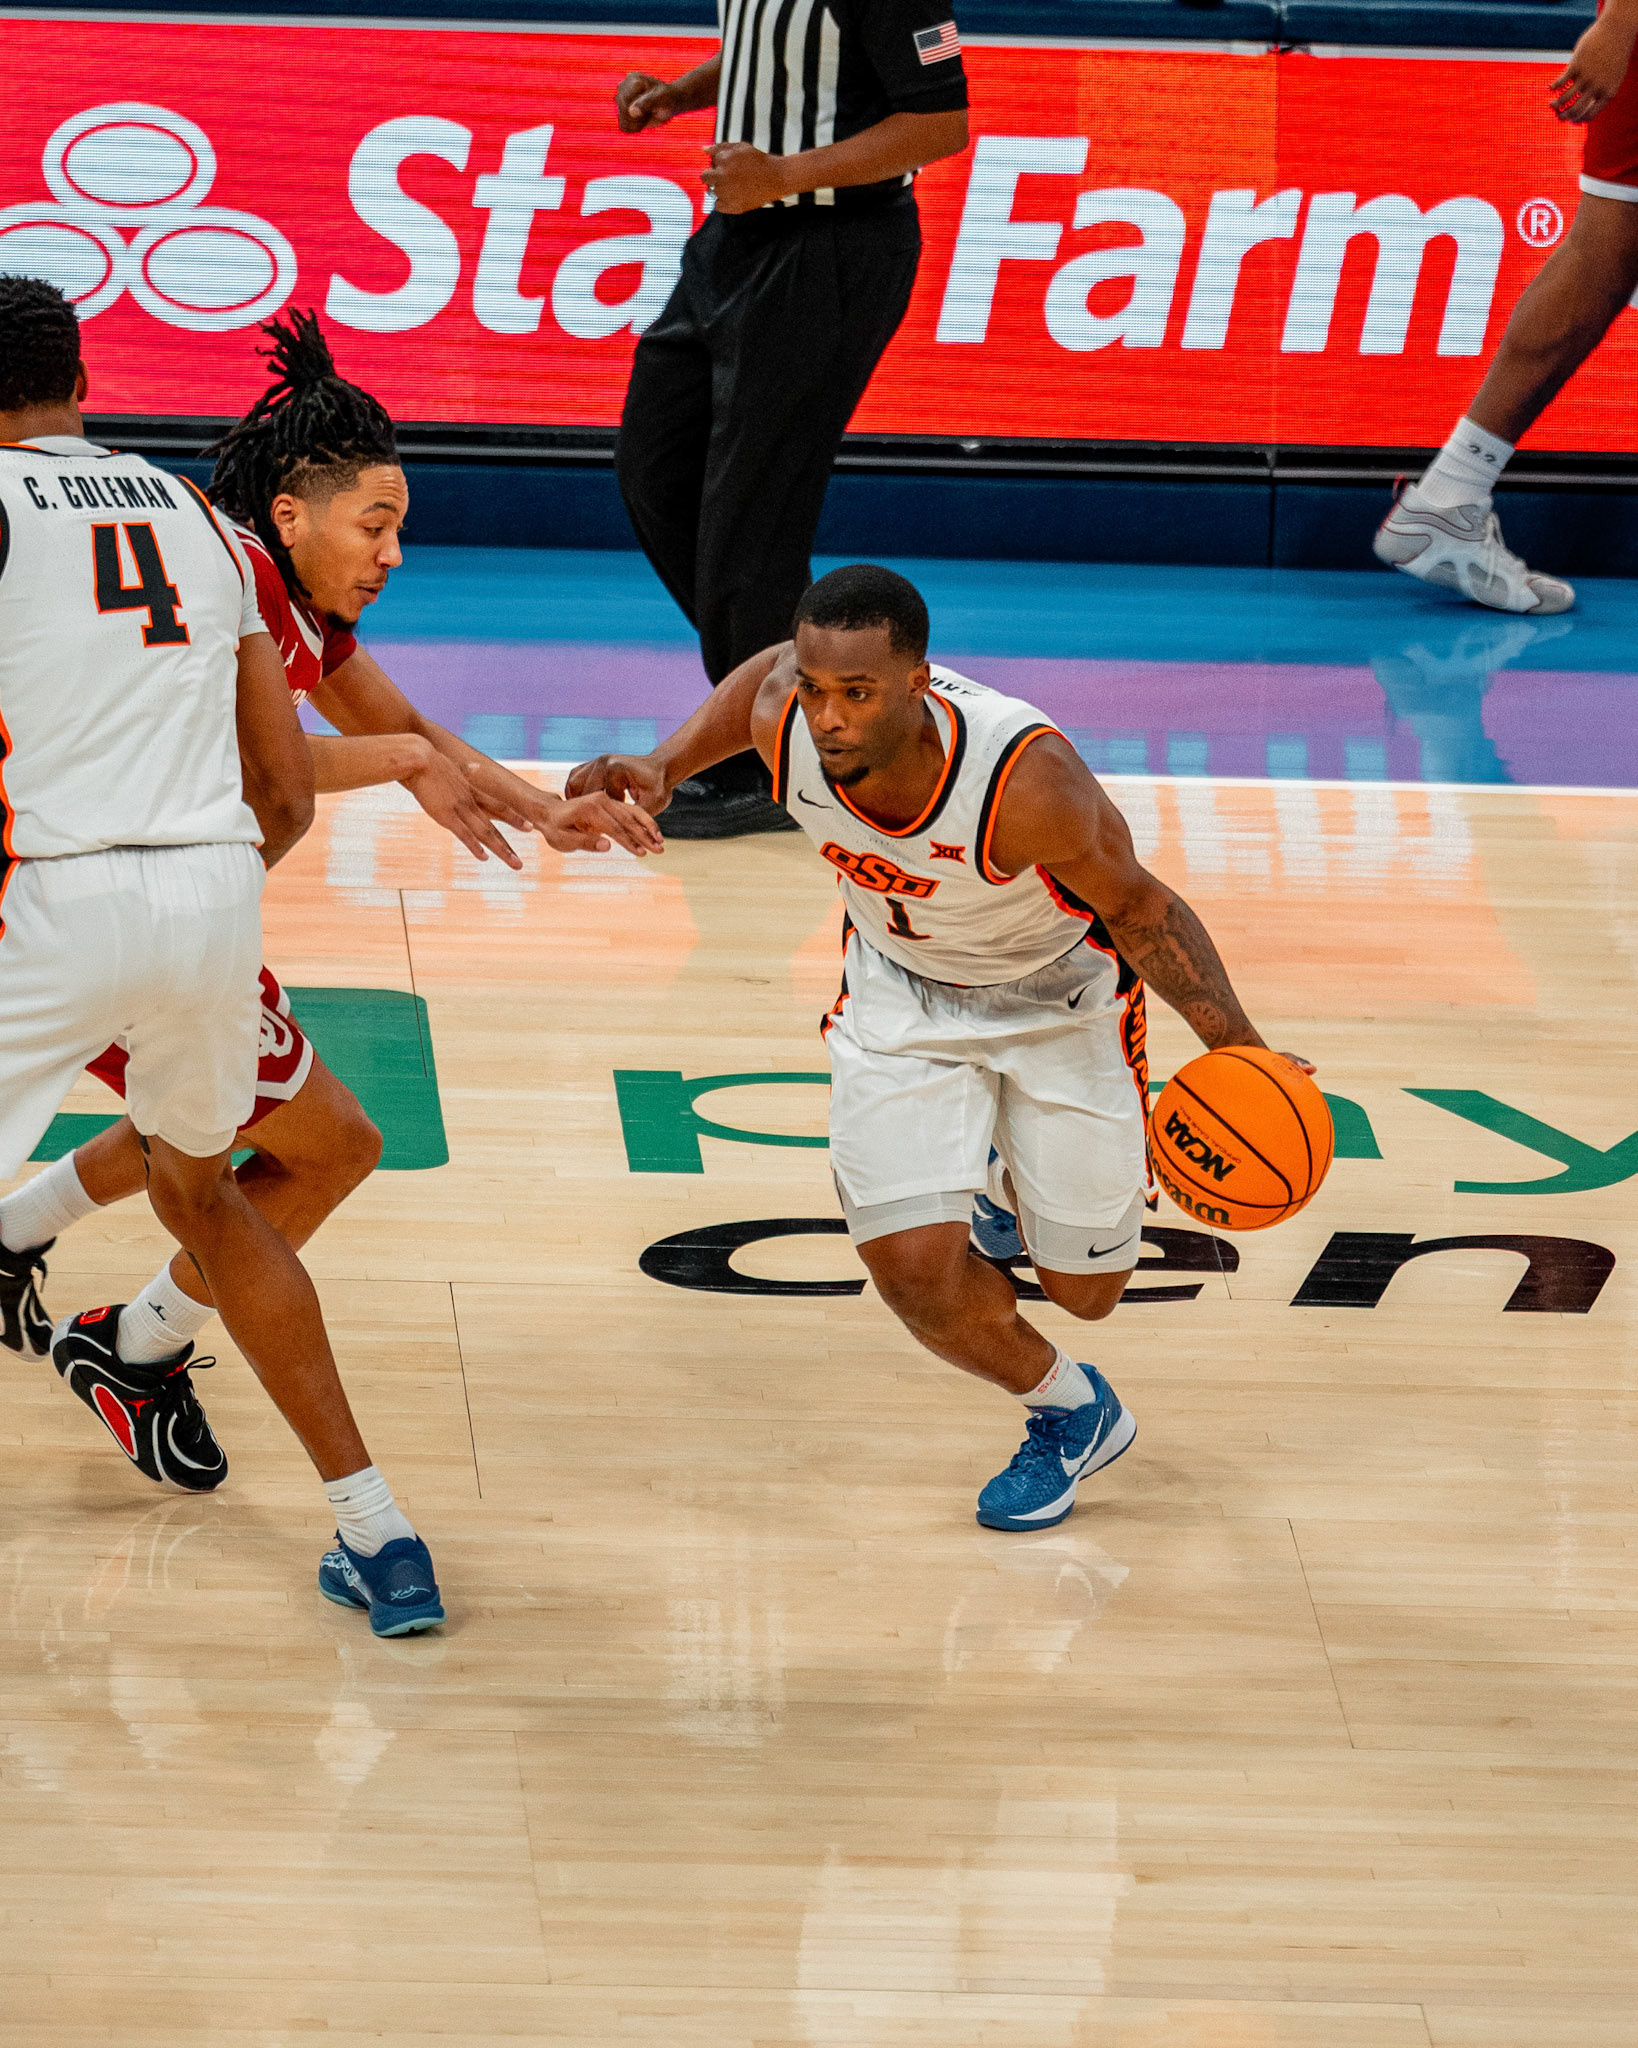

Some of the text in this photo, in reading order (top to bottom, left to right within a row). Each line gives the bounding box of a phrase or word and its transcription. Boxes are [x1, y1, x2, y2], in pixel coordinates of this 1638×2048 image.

[325, 115, 718, 339] Sta
[23, 476, 178, 510] C. COLEMAN
[91, 521, 191, 648] 4
[819, 841, 942, 899] OSU
[885, 896, 934, 941] 1
[1165, 1110, 1236, 1182] NCAA
